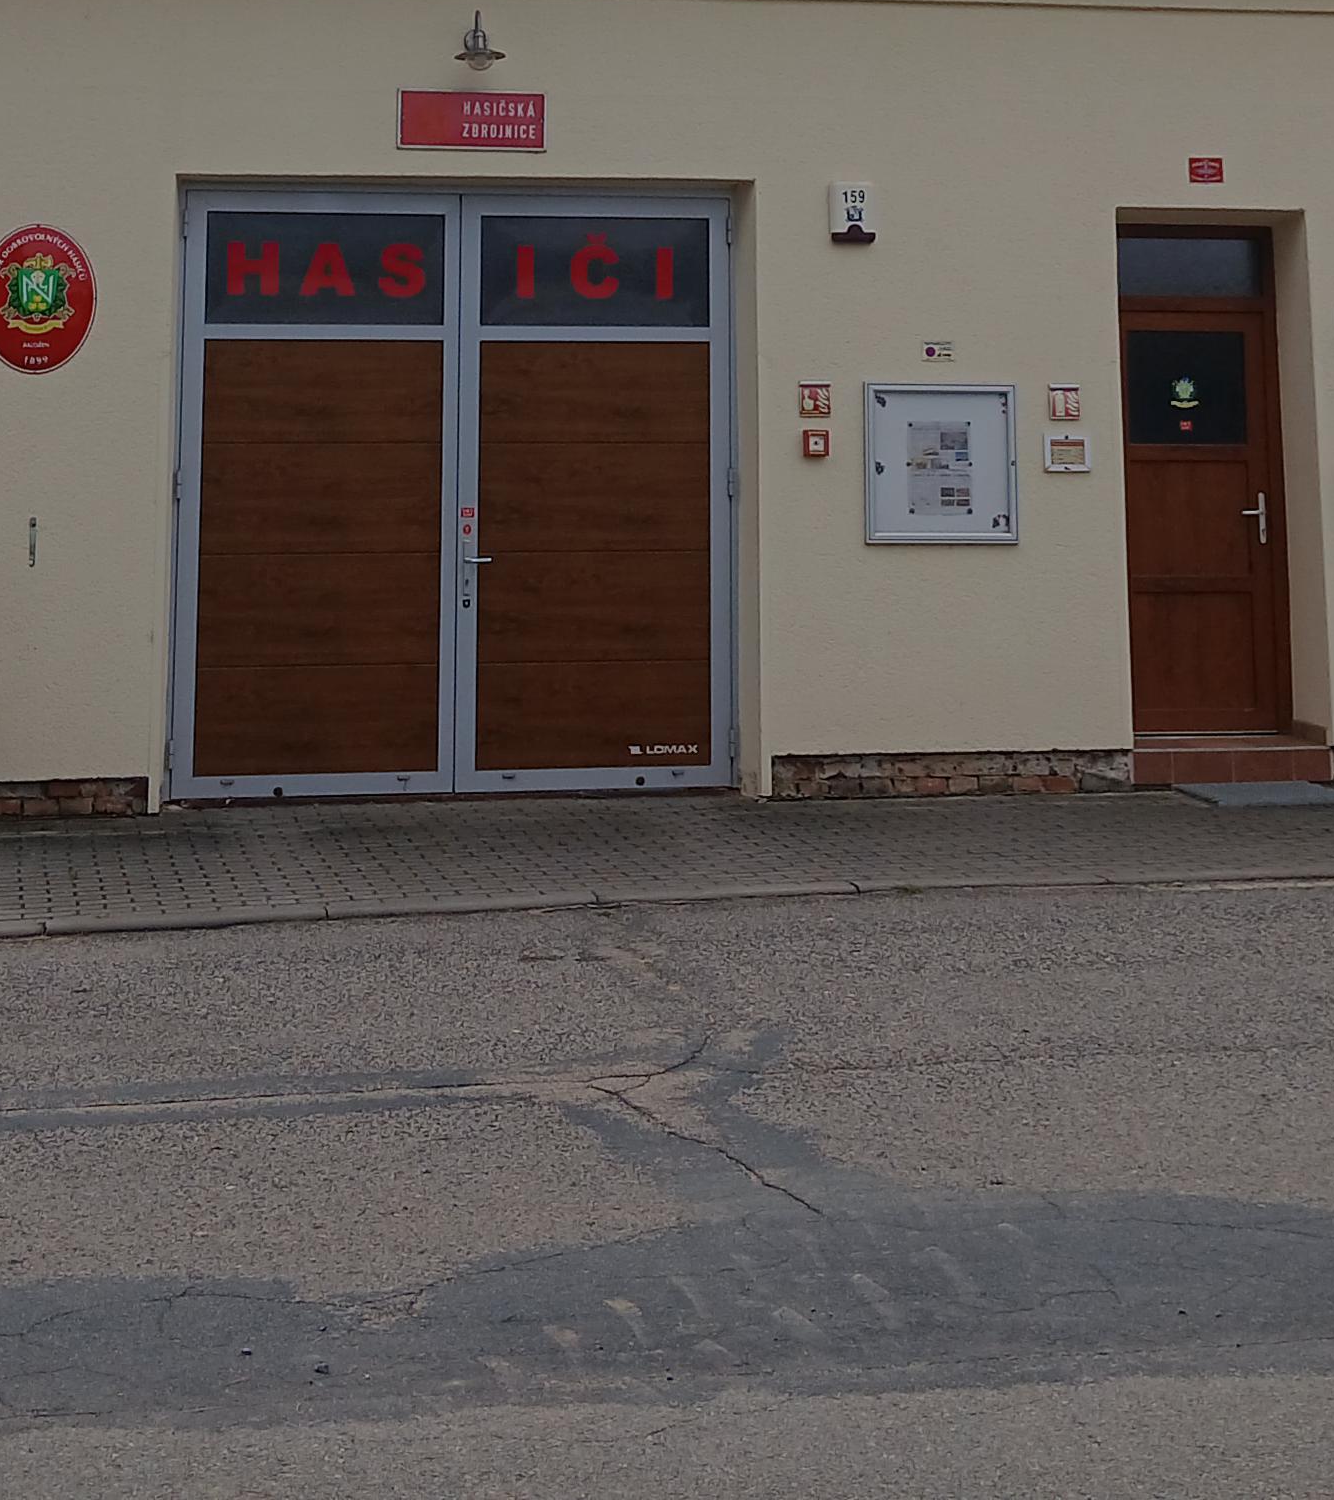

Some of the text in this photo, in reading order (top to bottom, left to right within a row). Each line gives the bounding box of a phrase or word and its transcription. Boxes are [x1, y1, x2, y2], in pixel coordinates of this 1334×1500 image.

[463, 100, 536, 117] HASIČSKÁ
[462, 123, 537, 139] ZBROJNICE
[842, 190, 866, 204] 159
[646, 744, 699, 755] LOMAX
